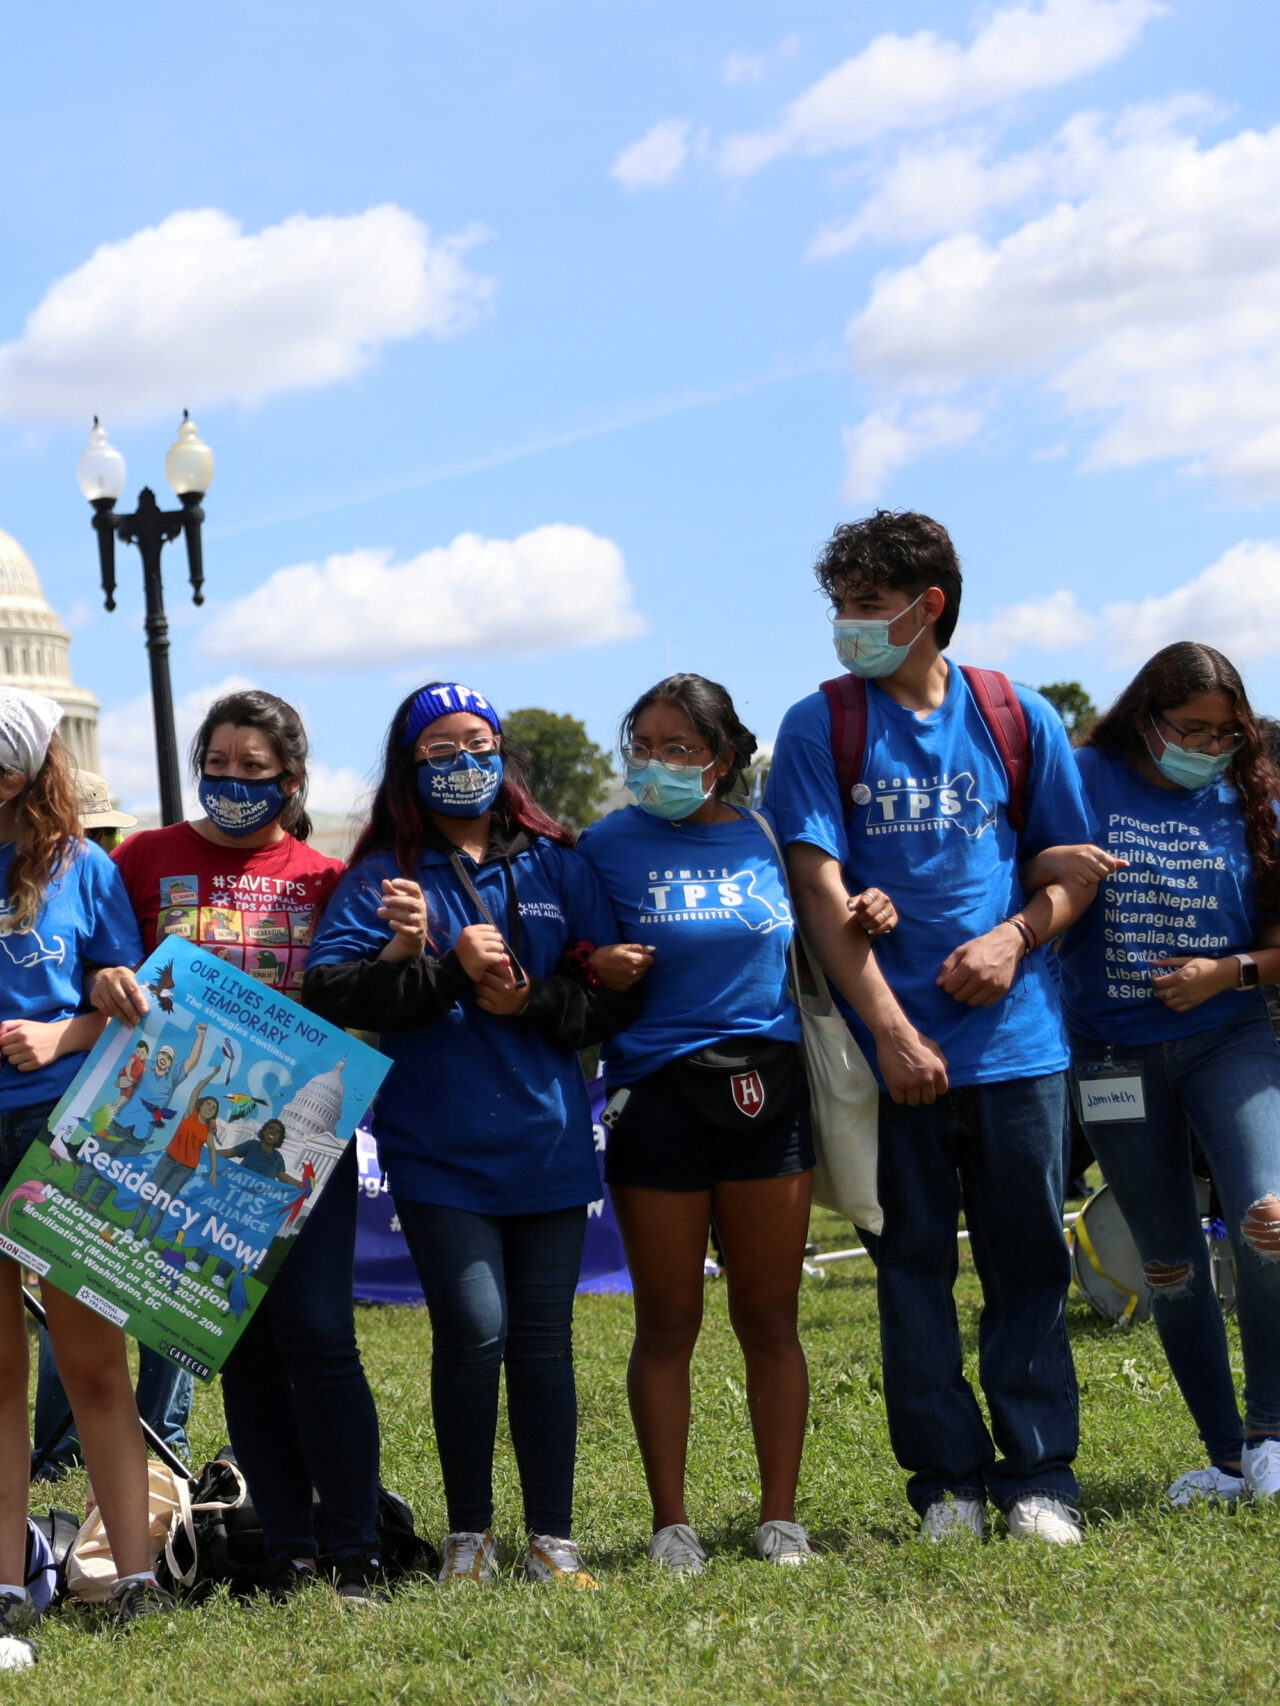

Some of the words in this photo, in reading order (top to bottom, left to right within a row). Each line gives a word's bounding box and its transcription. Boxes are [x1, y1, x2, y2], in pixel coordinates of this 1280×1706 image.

[431, 686, 488, 709] TPS
[877, 774, 949, 789] COMITÉ
[876, 790, 961, 820] TPS
[867, 821, 949, 835] MASSACHUSETTS
[1110, 814, 1200, 836] ProtectTPS
[1107, 849, 1226, 870] Haiti&Yemen&
[649, 868, 730, 880] COMITÉ
[1106, 870, 1198, 889] Honduras&
[212, 875, 306, 896] #SAVETPS
[234, 891, 297, 905] NATIONAL
[235, 901, 256, 911] TPS
[648, 883, 743, 910] TPS
[1105, 889, 1218, 911] Syria&Nepal&
[528, 902, 561, 913] NATION
[640, 911, 731, 923] MASSACHUSETTS
[1105, 909, 1196, 928] Nicaragua&
[1104, 929, 1228, 948] Somalia&Sudan
[190, 961, 220, 984] OUR
[220, 976, 263, 1009] LIVES
[264, 1004, 295, 1029] ARE
[295, 1021, 328, 1046] NOT
[202, 987, 288, 1045] TEMPORARY
[185, 994, 202, 1009] The
[204, 1006, 248, 1037] struggles
[250, 1036, 296, 1066] continues
[740, 1077, 759, 1105] H
[1087, 1092, 1135, 1107] Jamileth
[77, 1137, 200, 1231] Residency
[201, 1216, 268, 1270] Now!
[41, 1184, 109, 1233] National
[110, 1227, 143, 1254] TPS
[144, 1250, 229, 1311] Convention
[71, 1249, 81, 1260] in
[84, 1257, 142, 1300] Washington,
[145, 1296, 161, 1311] DC
[170, 1347, 209, 1377] CARECEN
